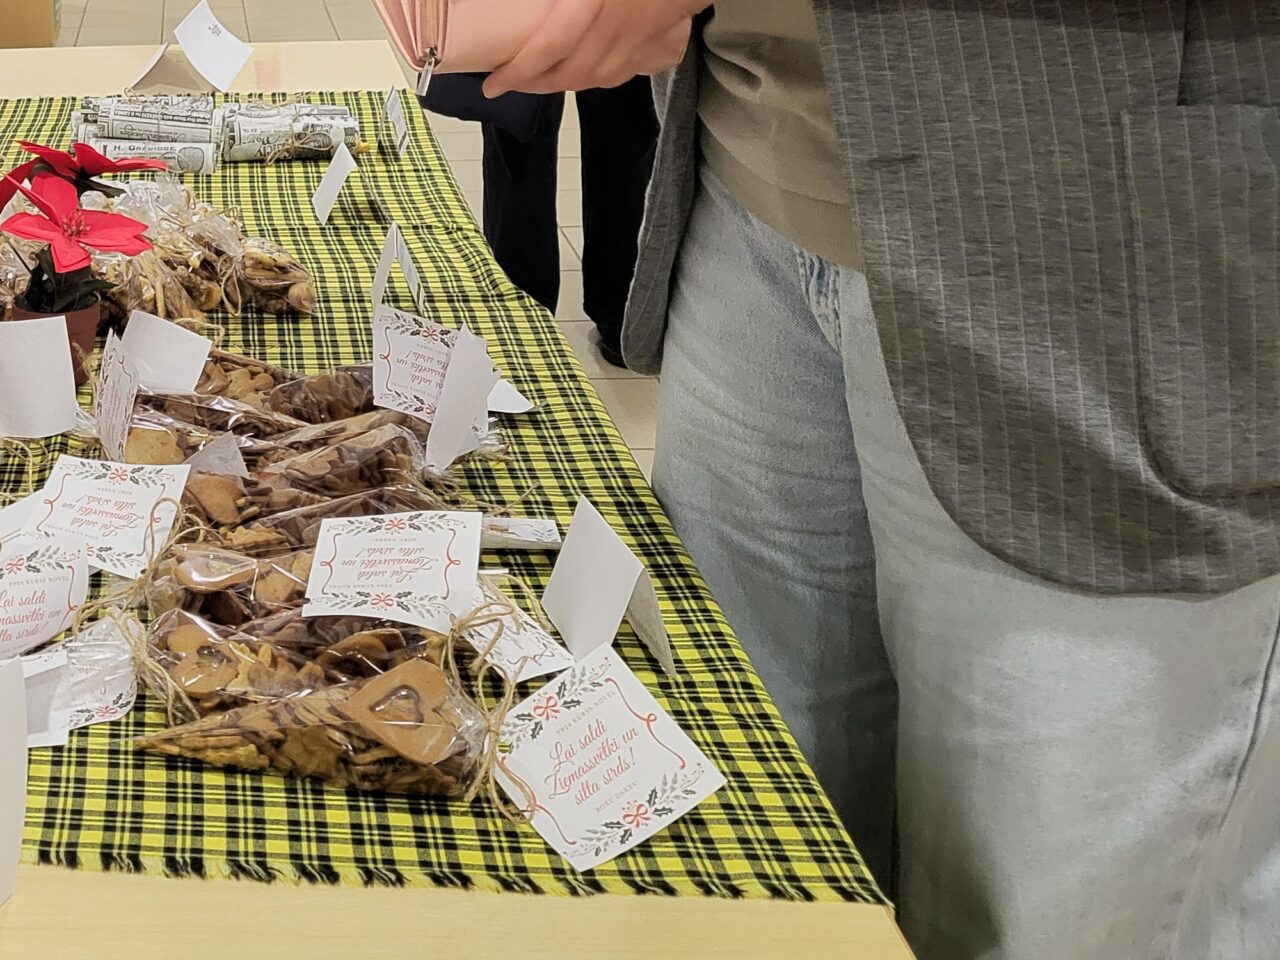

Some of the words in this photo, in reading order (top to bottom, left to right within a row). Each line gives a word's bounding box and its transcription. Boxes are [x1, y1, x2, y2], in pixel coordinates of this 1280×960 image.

[18, 590, 47, 607] saldi
[544, 737, 621, 800] Ziemassvētki
[622, 726, 639, 746] un
[549, 740, 577, 773] Lai
[579, 717, 608, 750] saldi
[575, 776, 601, 806] silta
[602, 746, 637, 785] sirds!
